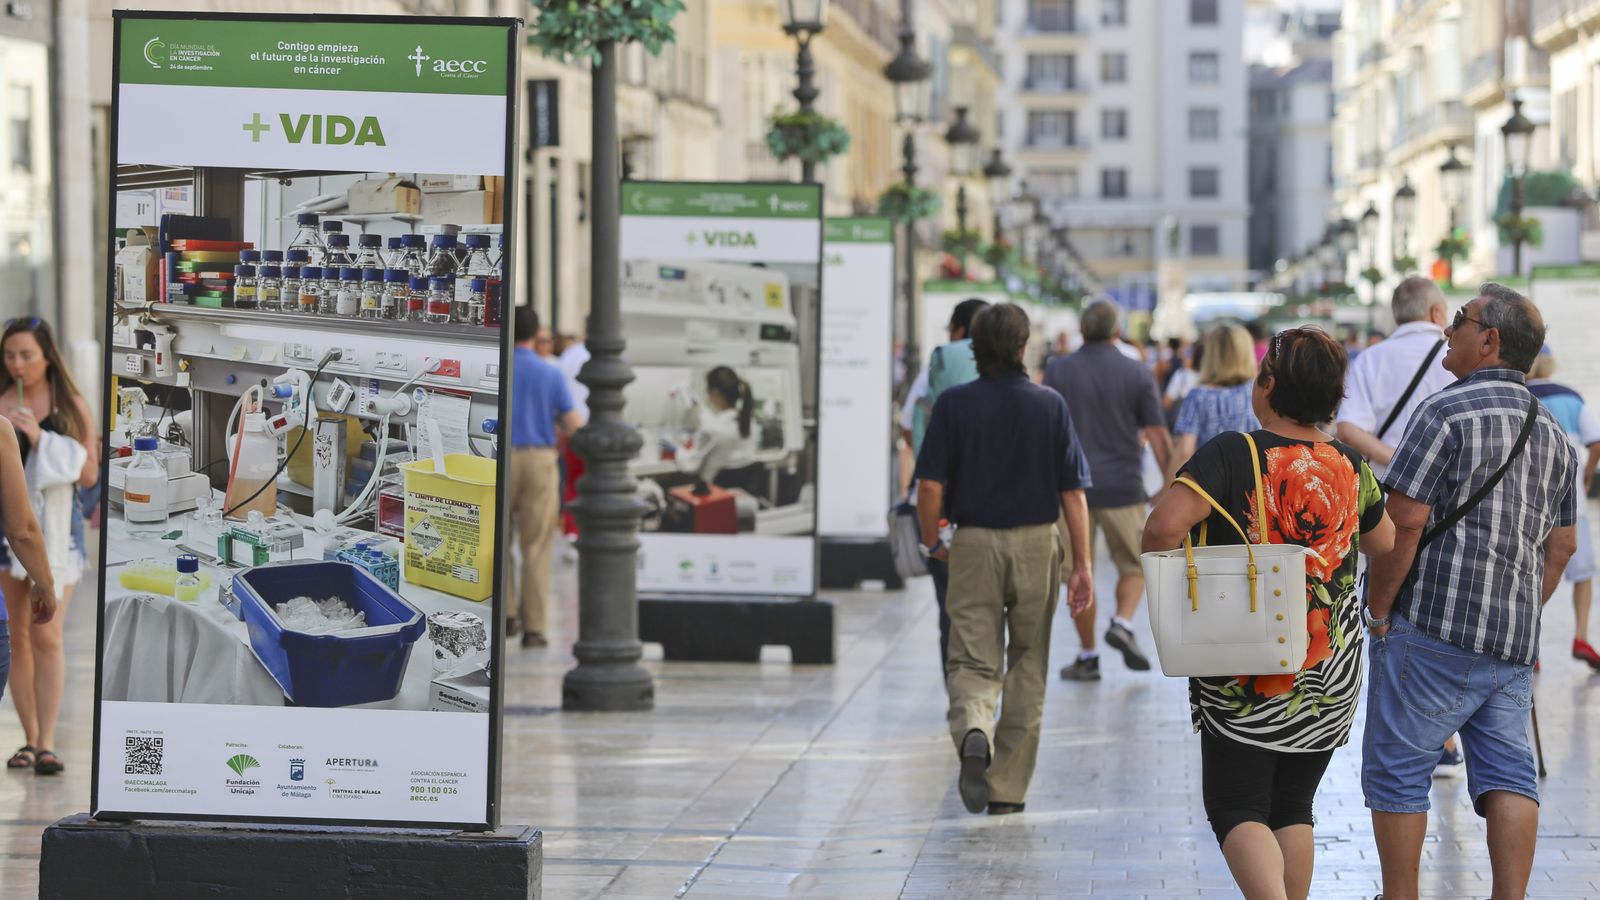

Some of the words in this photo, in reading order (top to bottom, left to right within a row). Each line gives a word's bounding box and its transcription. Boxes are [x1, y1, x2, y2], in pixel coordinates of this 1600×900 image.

[178, 49, 220, 57] INVESTIGACIÓN
[277, 41, 315, 53] Contigo
[317, 43, 359, 53] empieza
[250, 52, 260, 61] el
[262, 52, 293, 62] futuro
[295, 54, 307, 62] de
[309, 54, 319, 63] la
[321, 54, 385, 66] investigación
[294, 66, 306, 74] en
[308, 65, 341, 75] cáncer
[433, 59, 487, 73] aecc
[279, 114, 386, 146] VIDA
[704, 232, 757, 247] VIDA
[415, 493, 434, 502] LIMITE
[444, 498, 472, 509] LLENADO
[408, 505, 428, 513] PELIGRO
[326, 758, 378, 767] APERTURA
[427, 786, 441, 794] 100
[443, 787, 458, 795] 036
